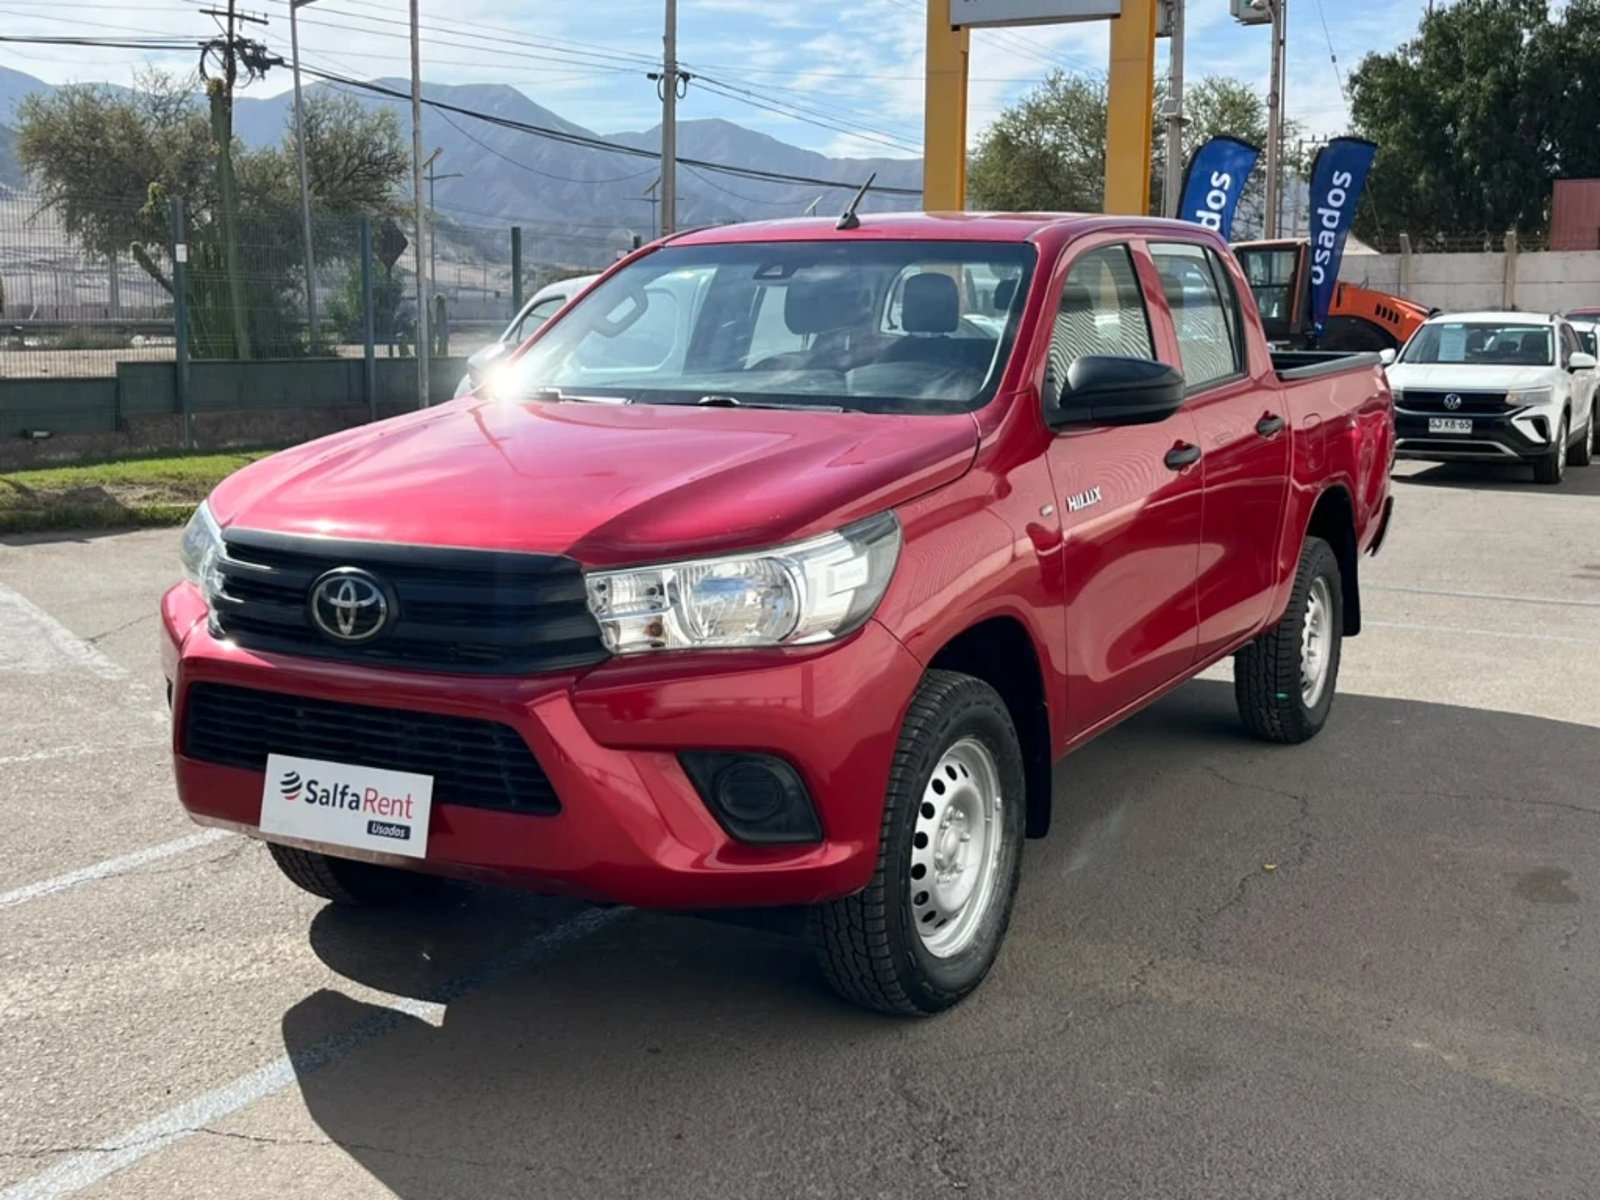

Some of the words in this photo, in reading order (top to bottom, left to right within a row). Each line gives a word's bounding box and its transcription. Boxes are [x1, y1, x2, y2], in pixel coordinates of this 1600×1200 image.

[1196, 171, 1231, 232] dos
[1066, 486, 1102, 512] HILUX
[305, 779, 414, 819] SalfaRent
[371, 822, 405, 838] Usados
